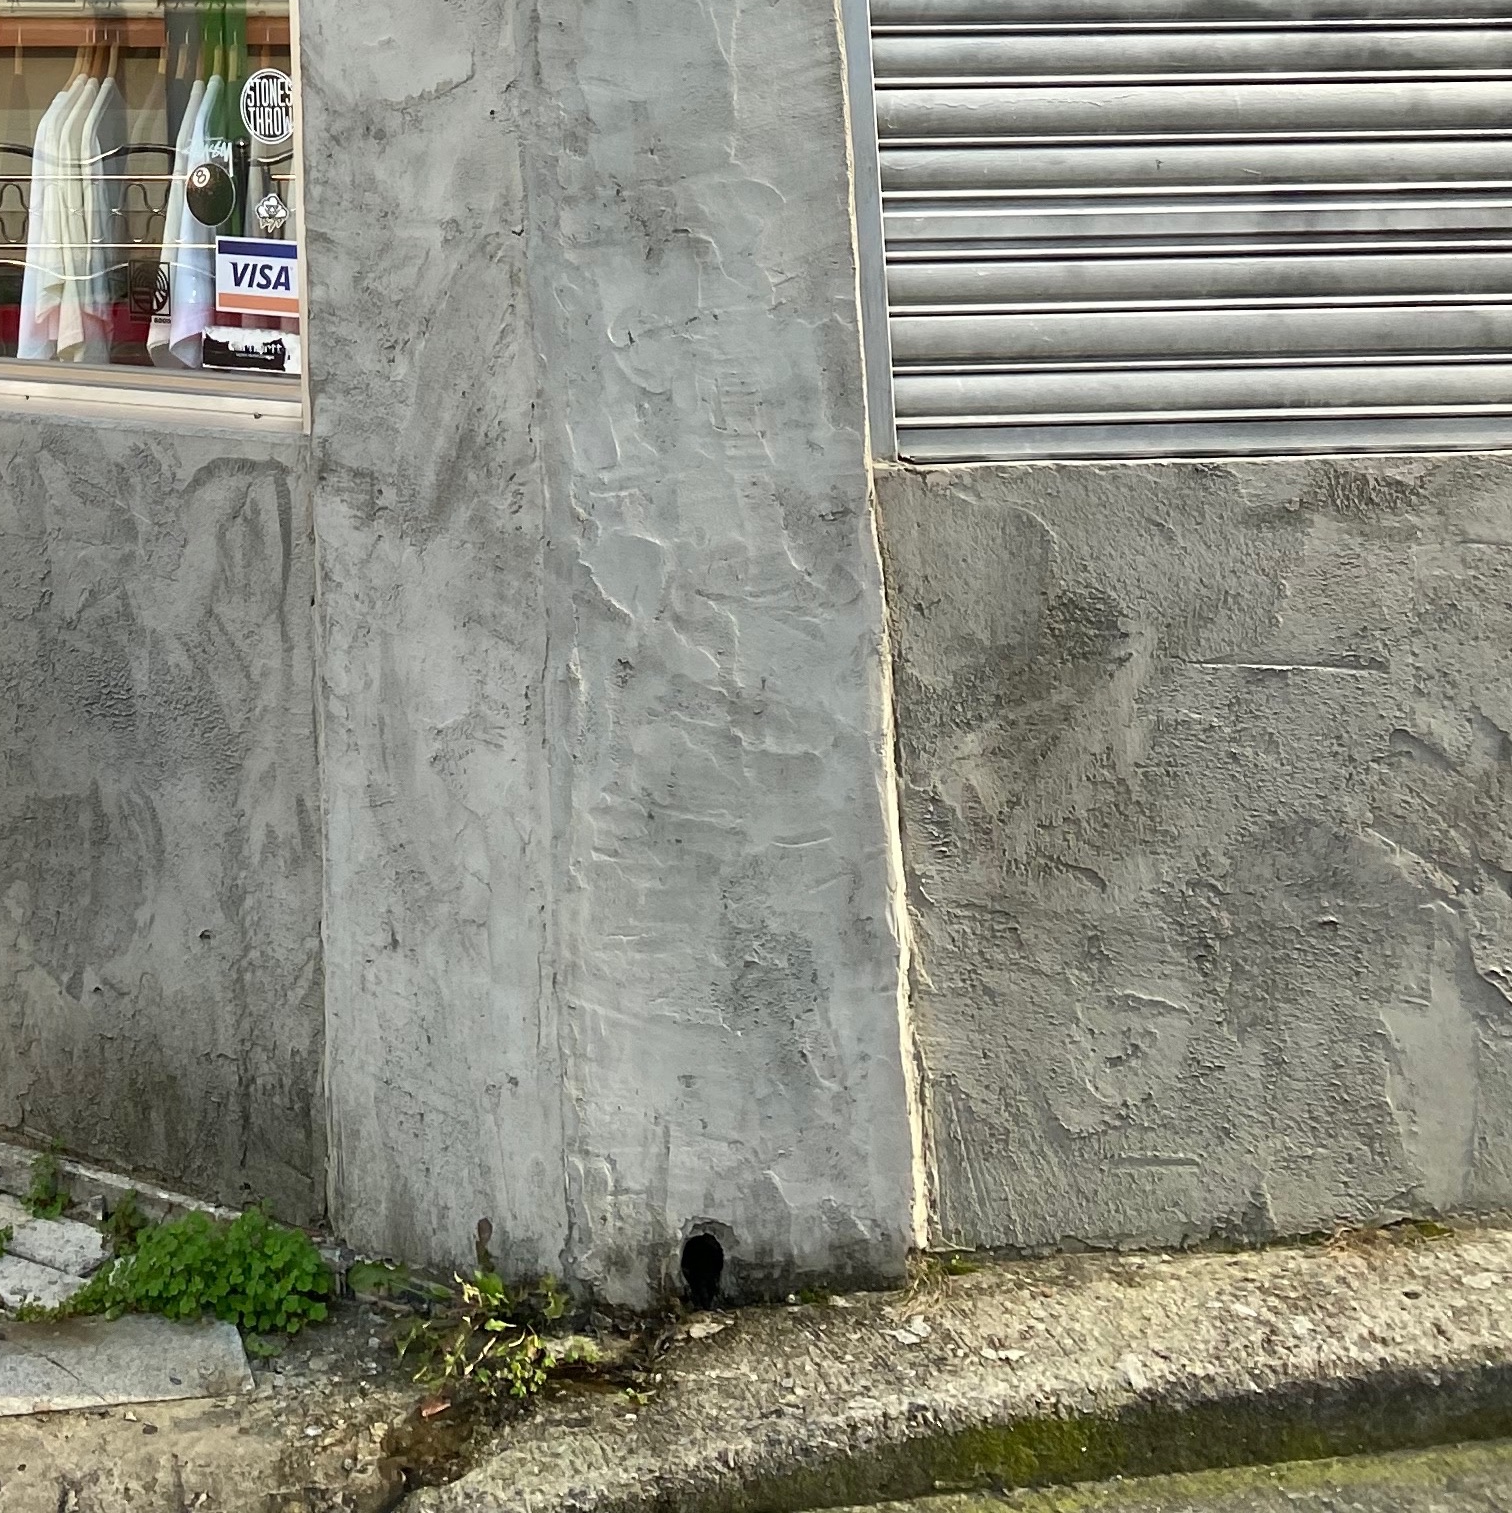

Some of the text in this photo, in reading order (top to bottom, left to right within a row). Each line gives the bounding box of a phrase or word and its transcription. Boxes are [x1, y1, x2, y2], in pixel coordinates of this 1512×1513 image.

[246, 78, 293, 106] STONES
[248, 107, 293, 136] THROW
[195, 169, 208, 184] 8
[229, 261, 291, 291] VISA
